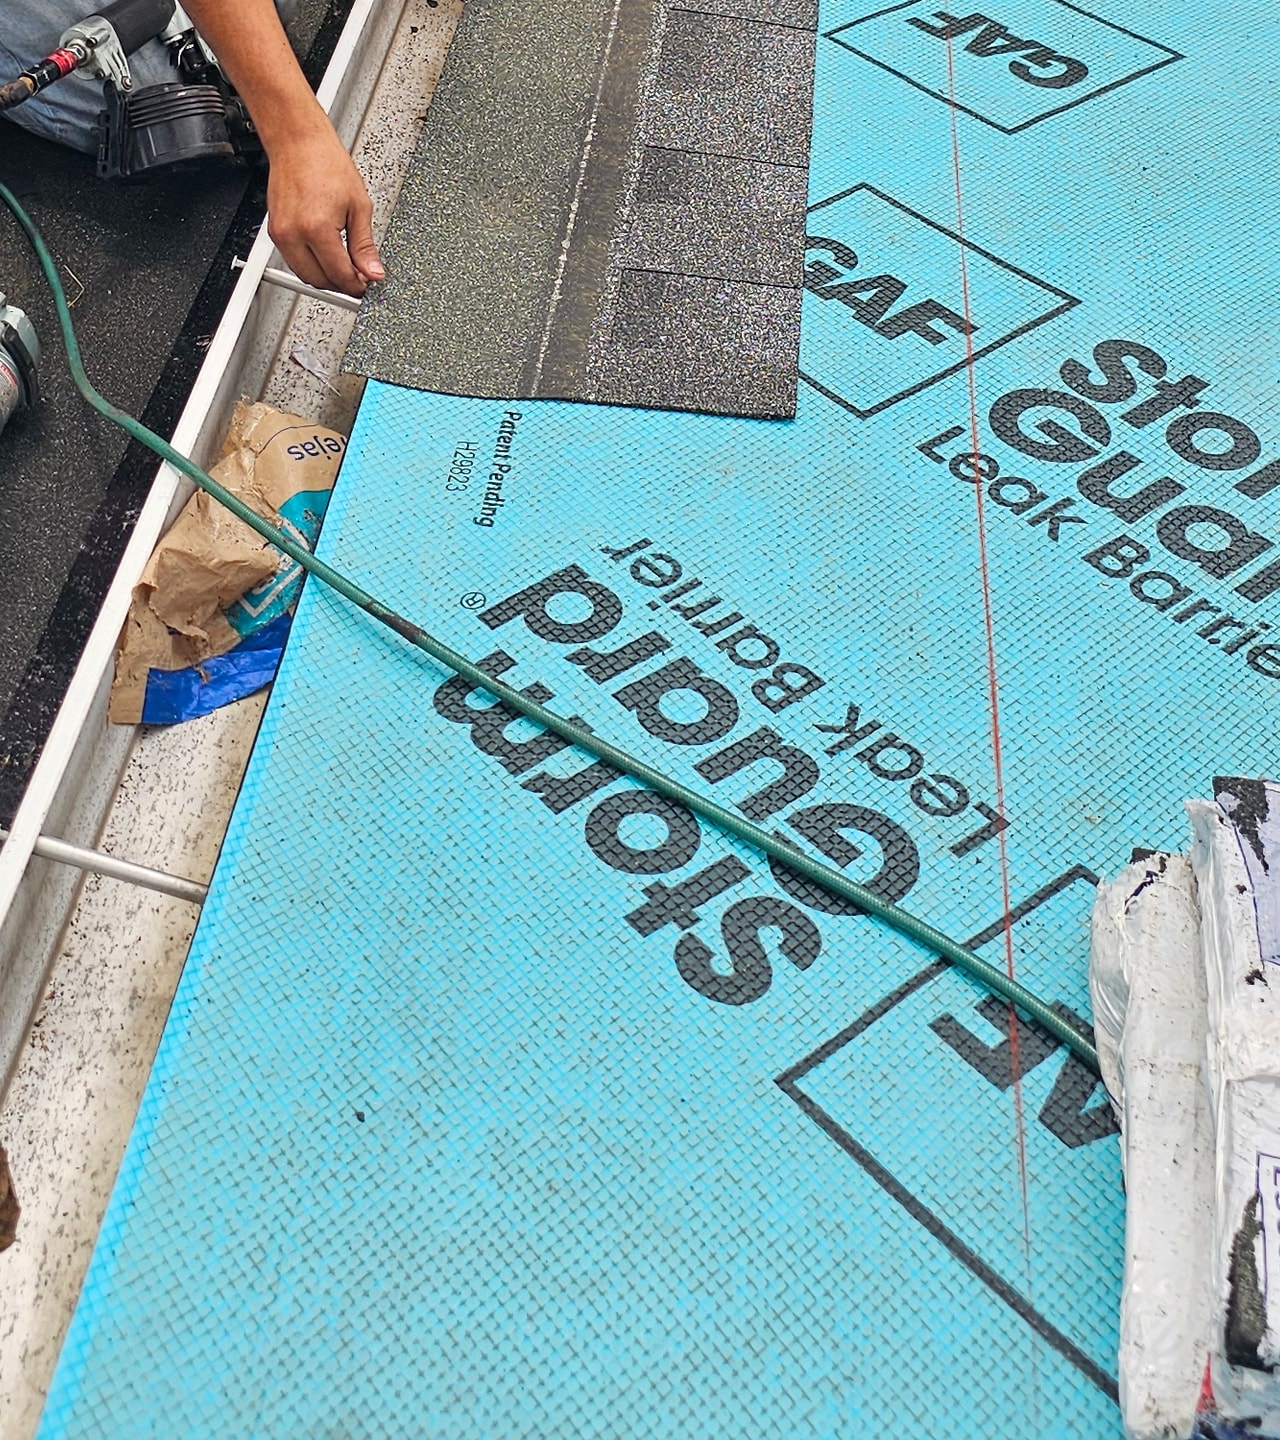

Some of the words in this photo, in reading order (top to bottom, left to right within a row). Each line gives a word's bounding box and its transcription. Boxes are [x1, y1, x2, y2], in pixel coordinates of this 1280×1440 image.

[904, 10, 1090, 89] GAF
[804, 234, 981, 346] GAF
[287, 436, 349, 463] ejas
[445, 441, 478, 491] H29823
[493, 411, 522, 458] Patent
[915, 426, 1089, 541] Leak
[473, 462, 511, 527] Pending
[599, 538, 826, 715] Barrier
[433, 650, 823, 1007] Storm
[815, 703, 1011, 858] Leak
[927, 996, 1122, 1150] AF
